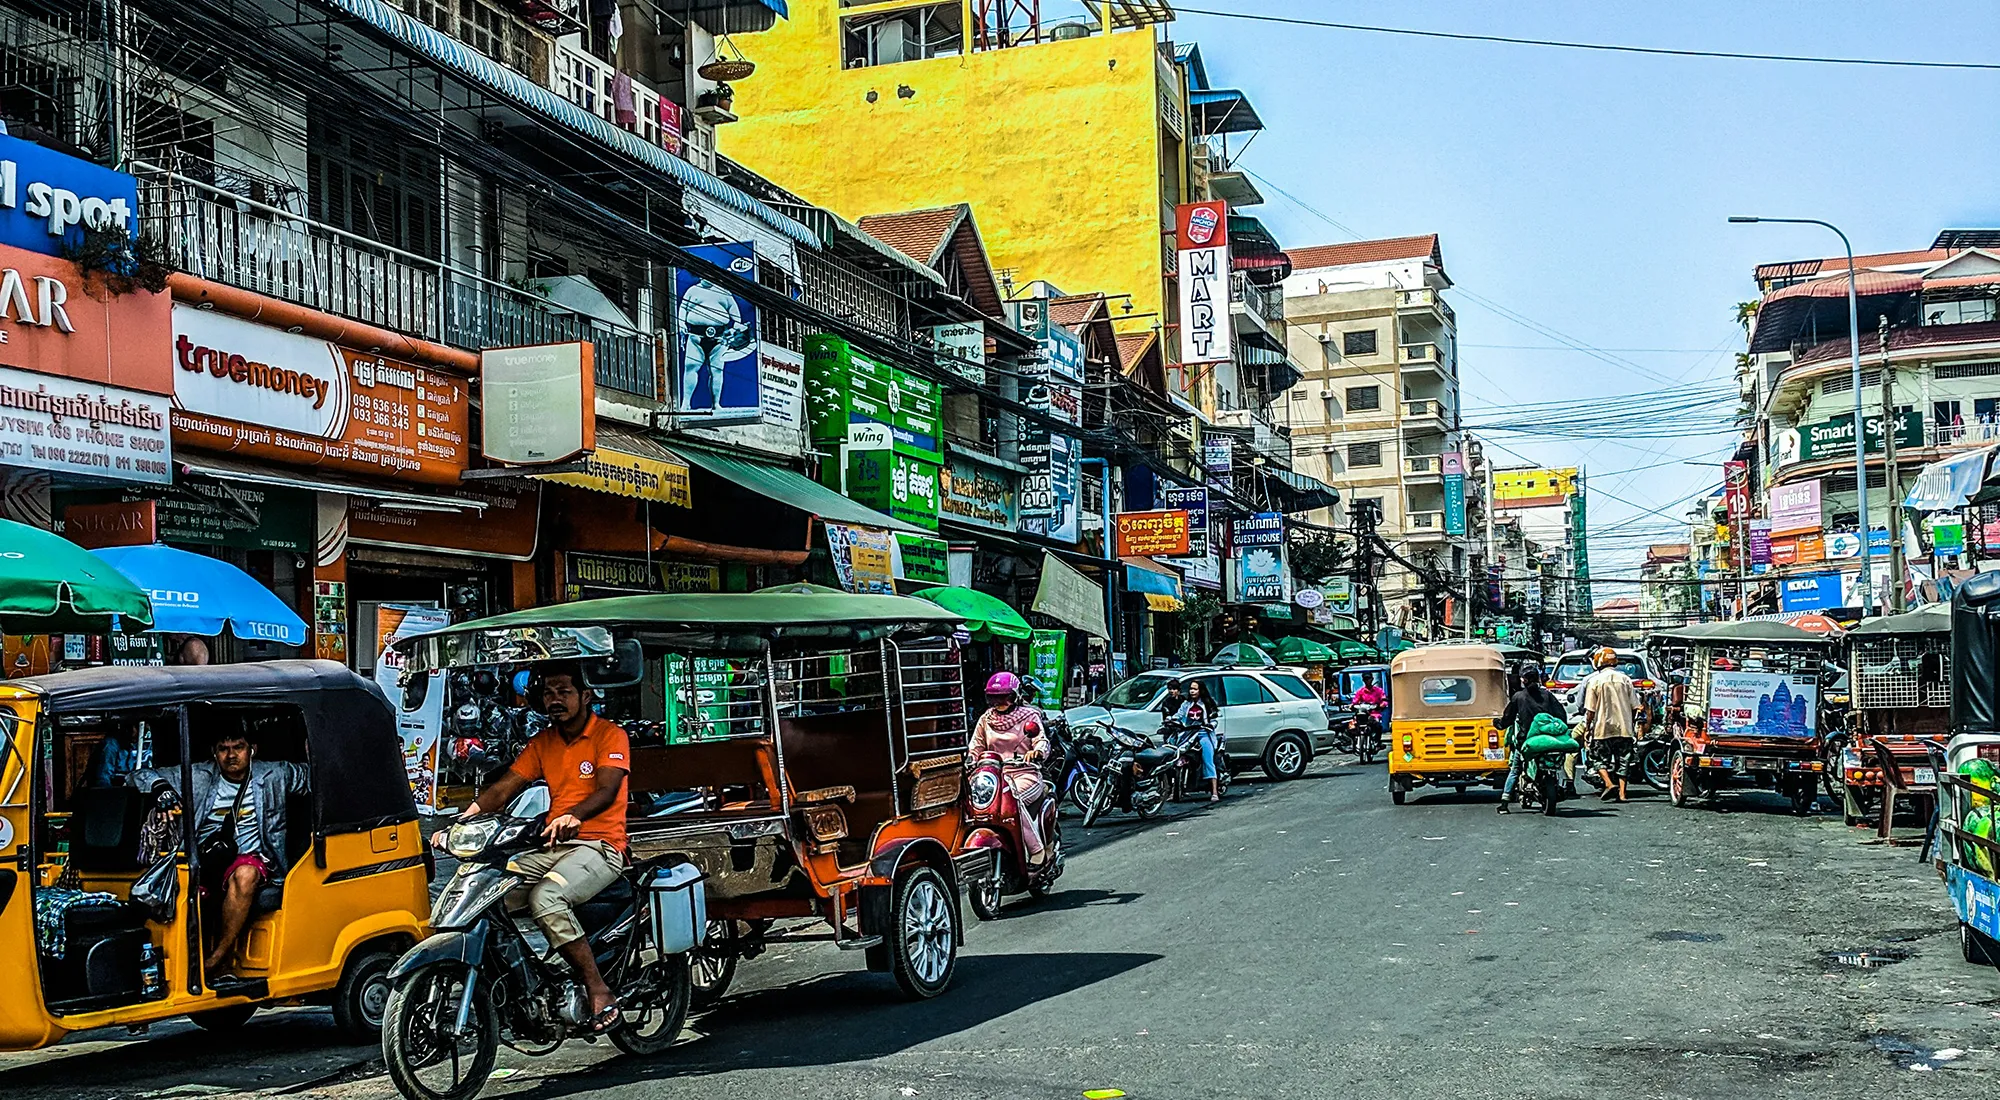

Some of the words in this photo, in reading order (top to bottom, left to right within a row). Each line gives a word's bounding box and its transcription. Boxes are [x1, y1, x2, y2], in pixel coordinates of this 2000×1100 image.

[25, 182, 131, 236] spot
[1190, 250, 1214, 356] MART
[504, 353, 557, 366] truemoney
[176, 334, 329, 410] truemoney
[353, 393, 371, 408] 099
[372, 398, 390, 413] 636
[391, 402, 409, 418] 345
[353, 407, 371, 423] 093
[373, 411, 390, 427] 366
[392, 415, 410, 430] 345
[47, 424, 72, 440] 168
[76, 428, 124, 448] PHONE
[130, 436, 165, 453] SHOP
[853, 432, 884, 447] Wing
[1810, 421, 1855, 441] Smart
[72, 510, 144, 533] SUGAR
[1233, 535, 1255, 544] GUEST
[1256, 533, 1280, 543] HOUSE
[1245, 576, 1279, 584] SUNFLOWER
[1247, 586, 1280, 597] MART
[249, 621, 289, 640] TECNO
